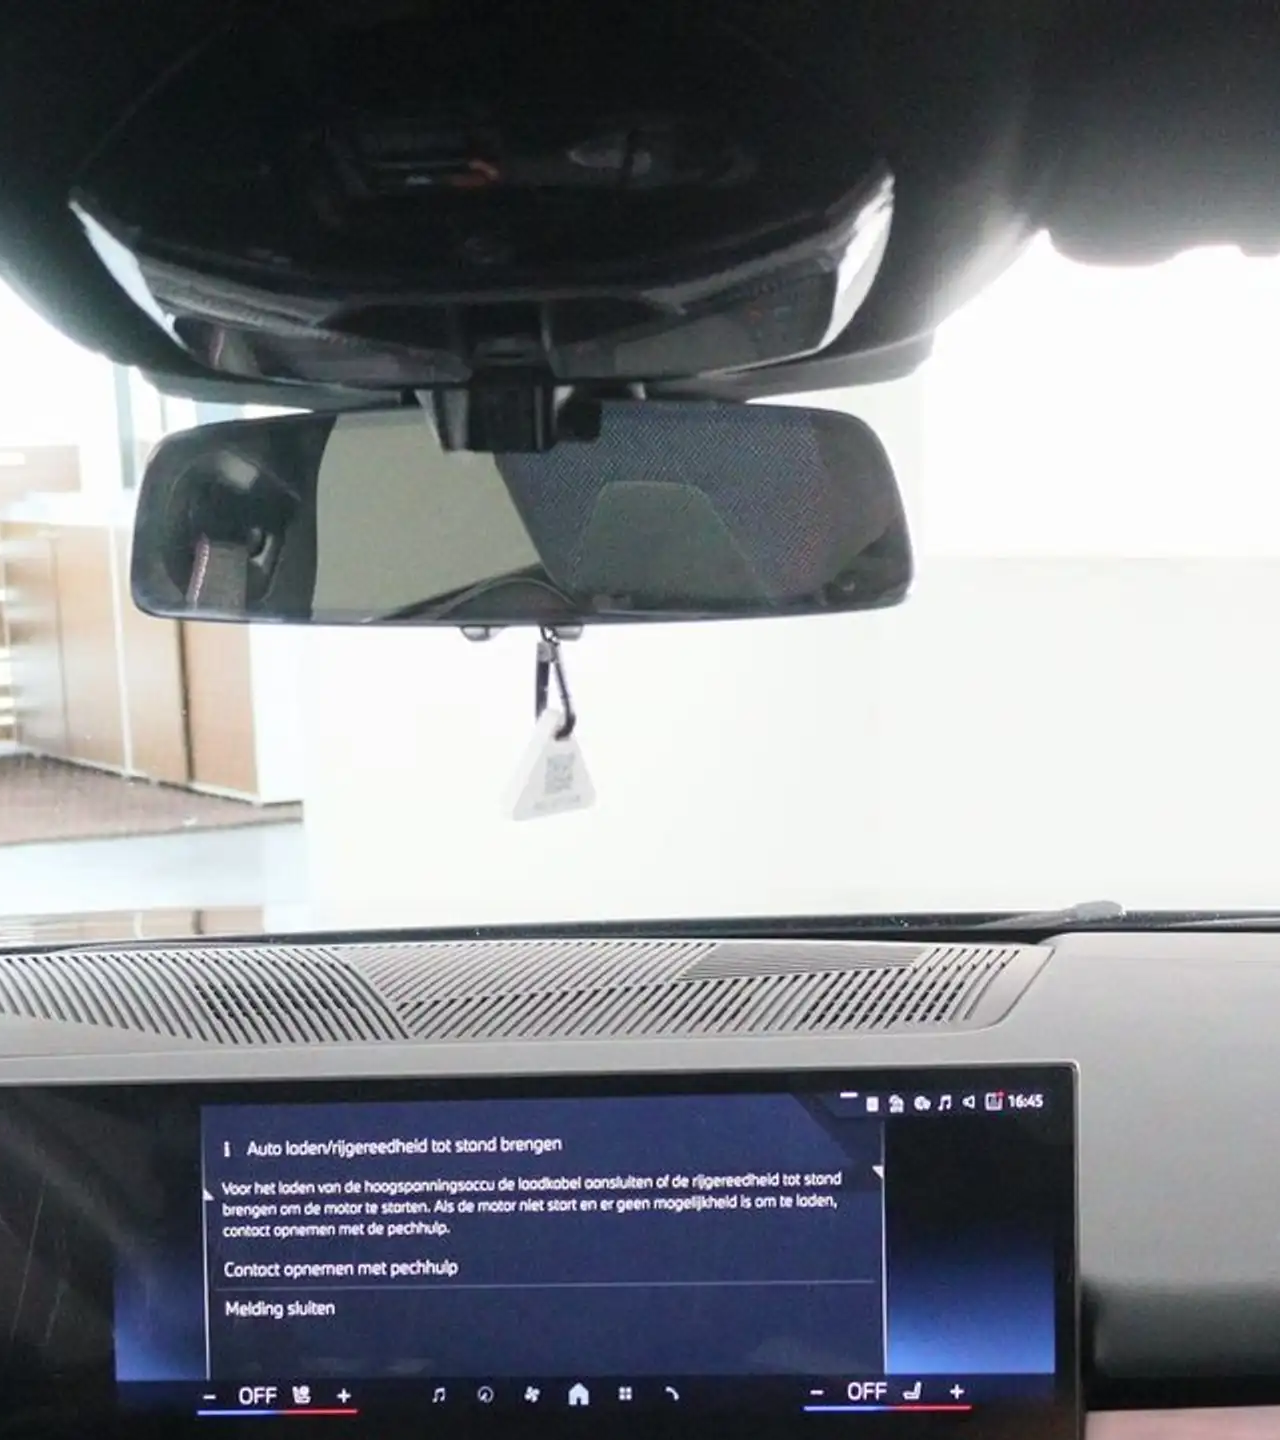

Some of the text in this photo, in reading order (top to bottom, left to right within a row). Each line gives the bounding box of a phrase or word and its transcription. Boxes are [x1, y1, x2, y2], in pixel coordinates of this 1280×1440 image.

[1007, 1093, 1045, 1109] 16:45
[246, 1140, 283, 1156] Auto
[285, 1138, 428, 1158] laden/rijgereedheid
[430, 1137, 452, 1153] tot
[454, 1136, 498, 1152] stand
[499, 1135, 564, 1155] brengen
[221, 1171, 843, 1195] Voor het laden van de hoogspanningsaccu de laadkabel aansluiten of de rijgereedheid tot stand
[221, 1193, 839, 1219] brengen om de motor te starten. Als de motor niet start en er geen mogelijkheid is om te laden,
[222, 1220, 452, 1240] contact opnemen met de pechhulp.
[223, 1259, 459, 1280] Contact opnemen met pechhulp
[224, 1299, 336, 1320] Melding sluiten
[238, 1386, 278, 1406] OFF
[847, 1381, 888, 1401] OFF
